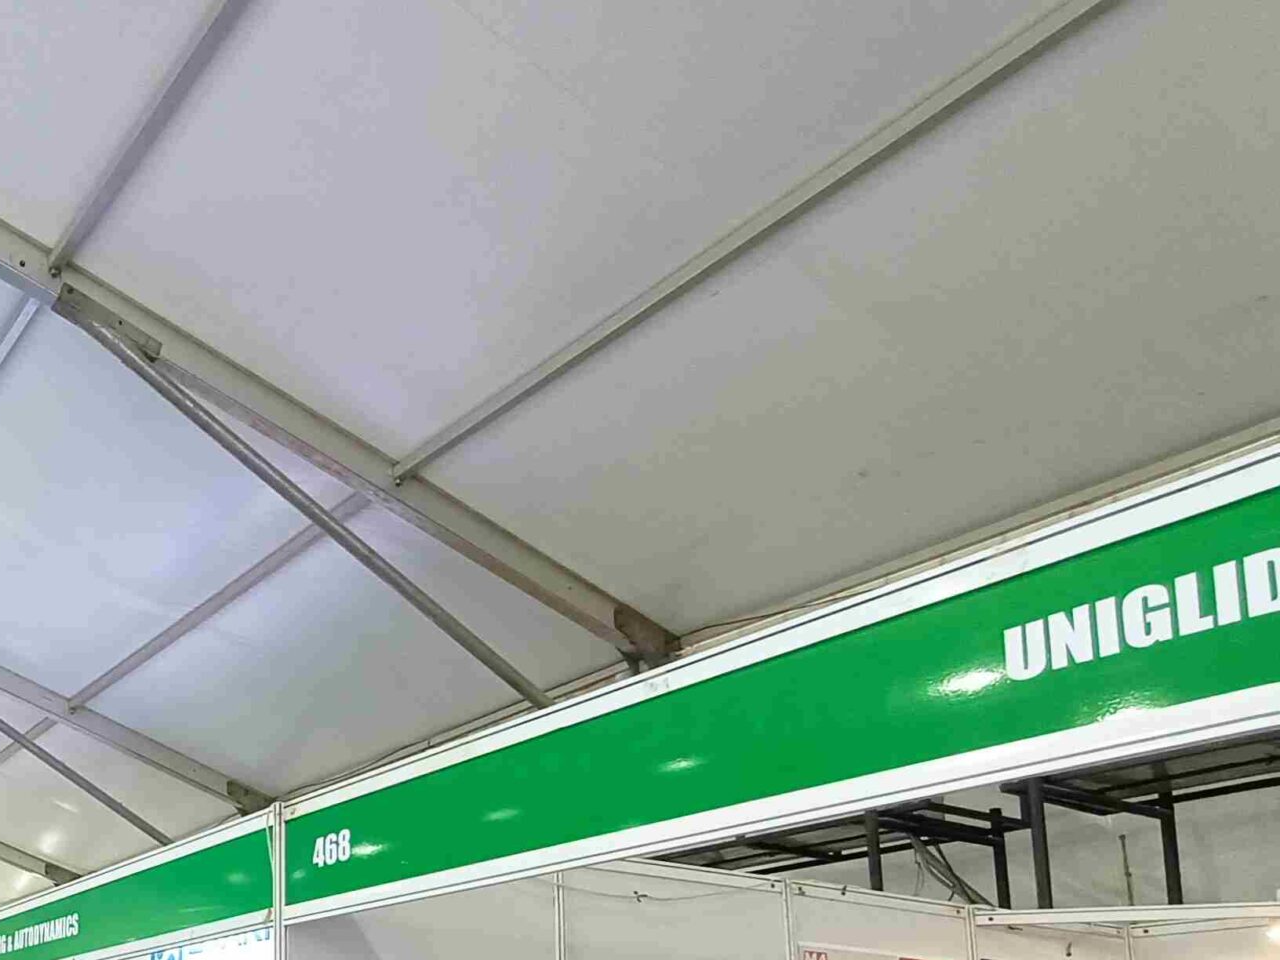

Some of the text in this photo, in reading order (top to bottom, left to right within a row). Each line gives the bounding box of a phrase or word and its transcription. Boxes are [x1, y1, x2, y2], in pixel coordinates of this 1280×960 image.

[1004, 547, 1280, 681] UNIGLID
[312, 829, 351, 868] 468
[7, 935, 13, 953] &
[14, 913, 79, 951] AUTODYNAMICS
